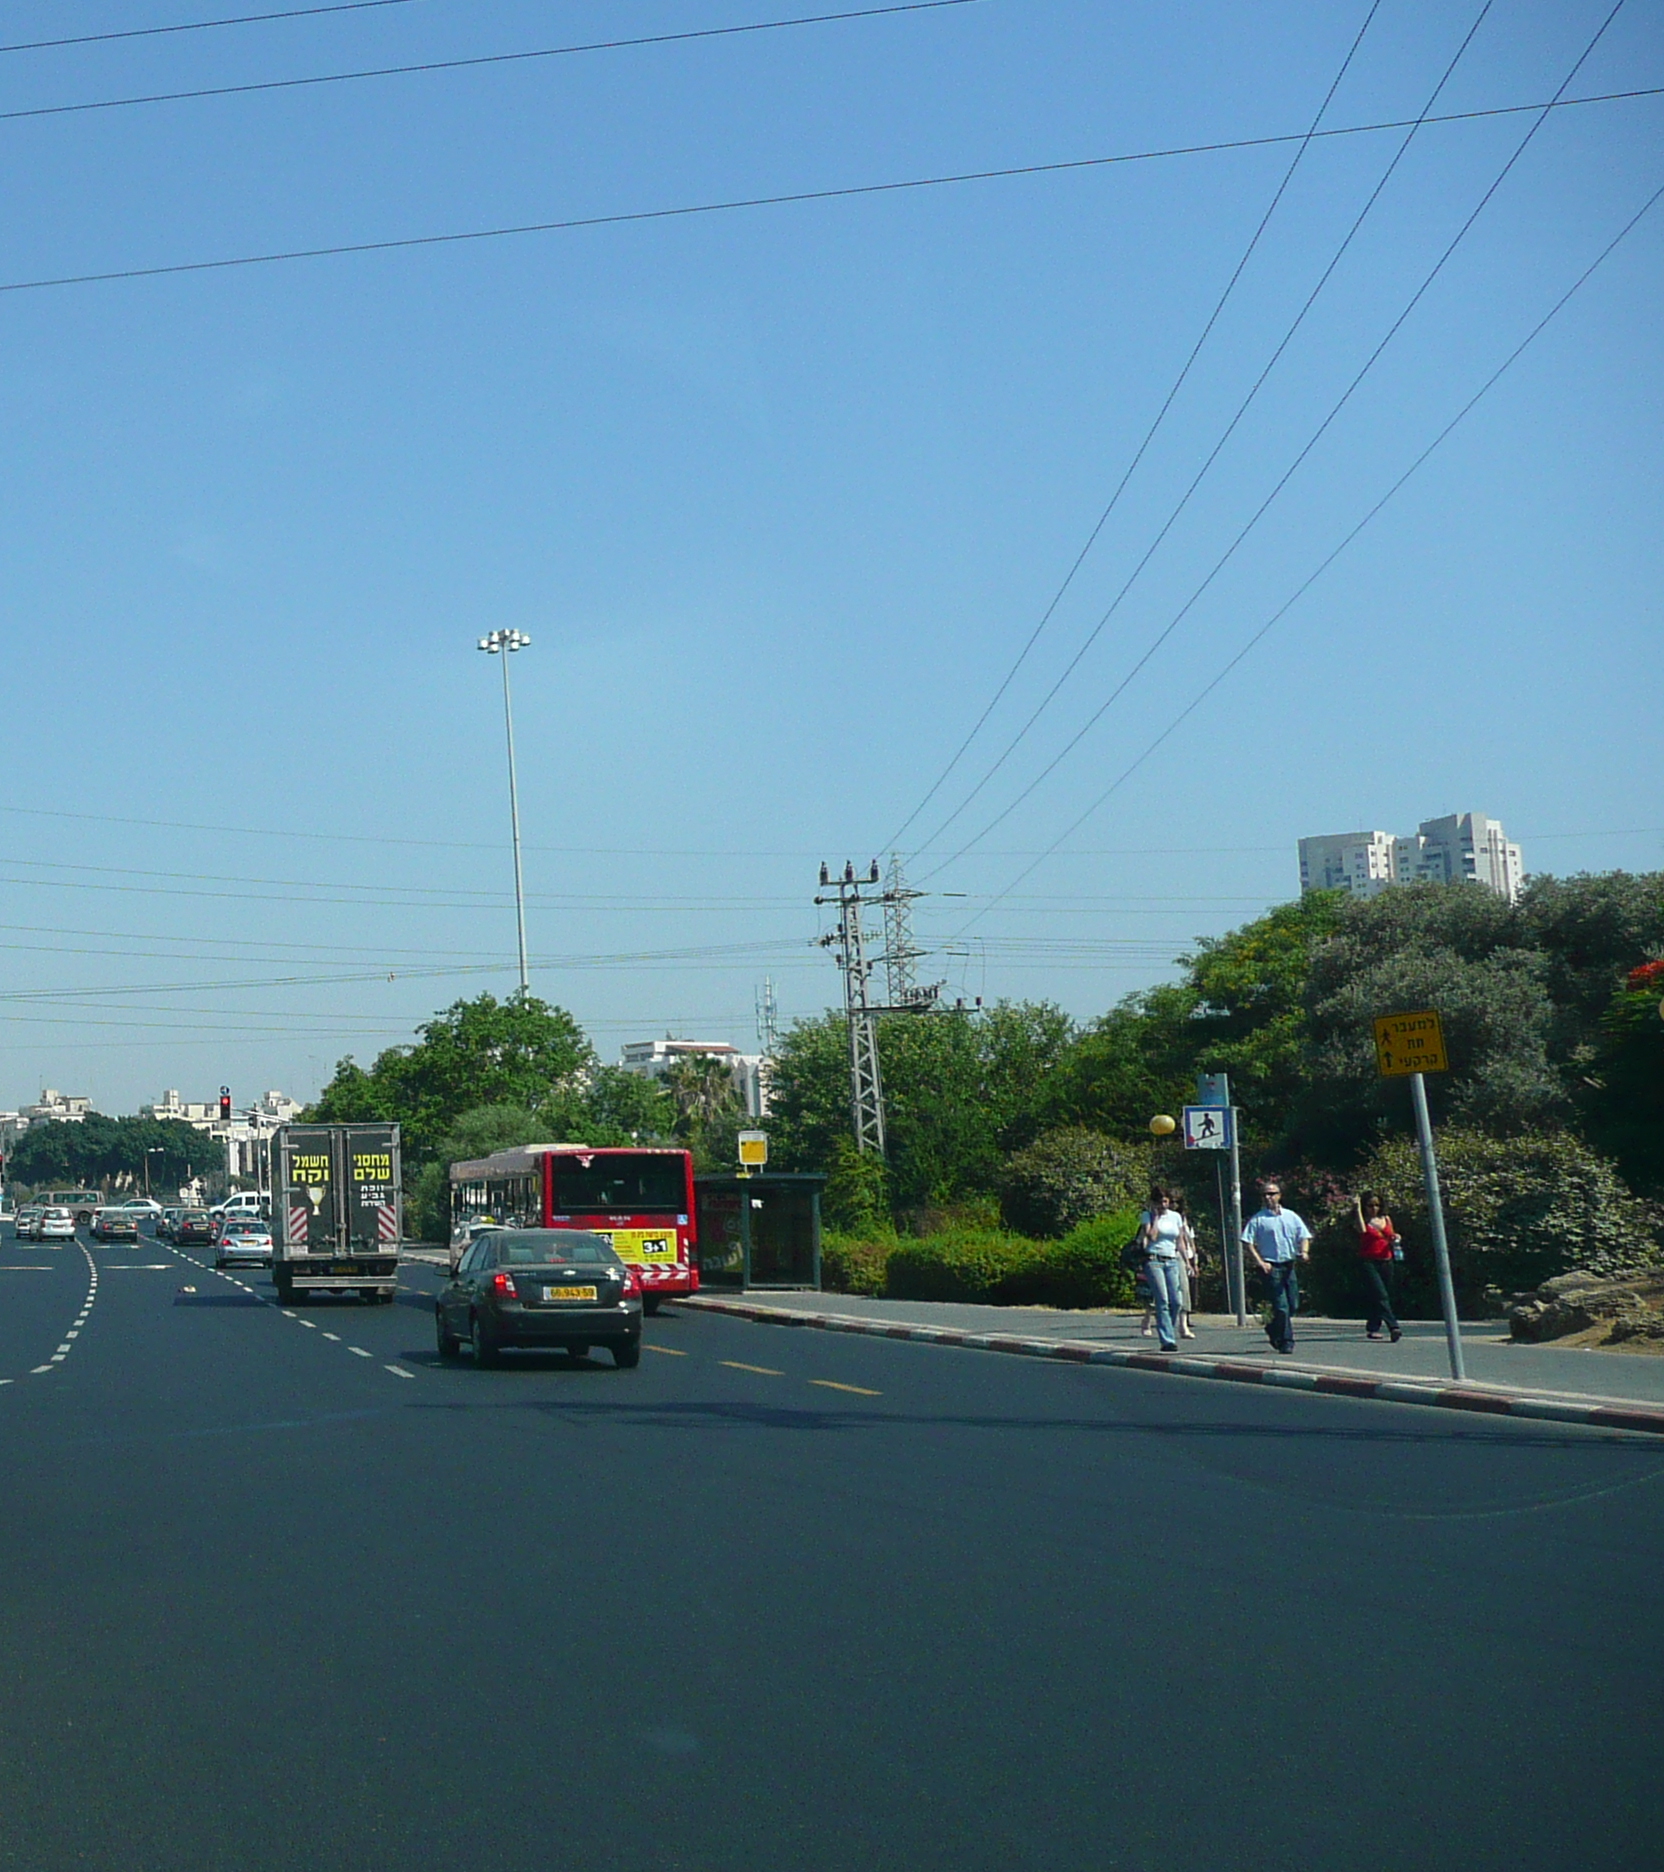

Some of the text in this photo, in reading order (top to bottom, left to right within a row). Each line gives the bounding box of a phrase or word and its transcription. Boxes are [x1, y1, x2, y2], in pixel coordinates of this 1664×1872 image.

[1391, 1017, 1435, 1033] למעבר
[1399, 1053, 1438, 1068] קרקעי
[292, 1154, 390, 1168] מחסני חשמל
[292, 1167, 391, 1184] שלם וקח
[643, 1240, 667, 1253] 3+1
